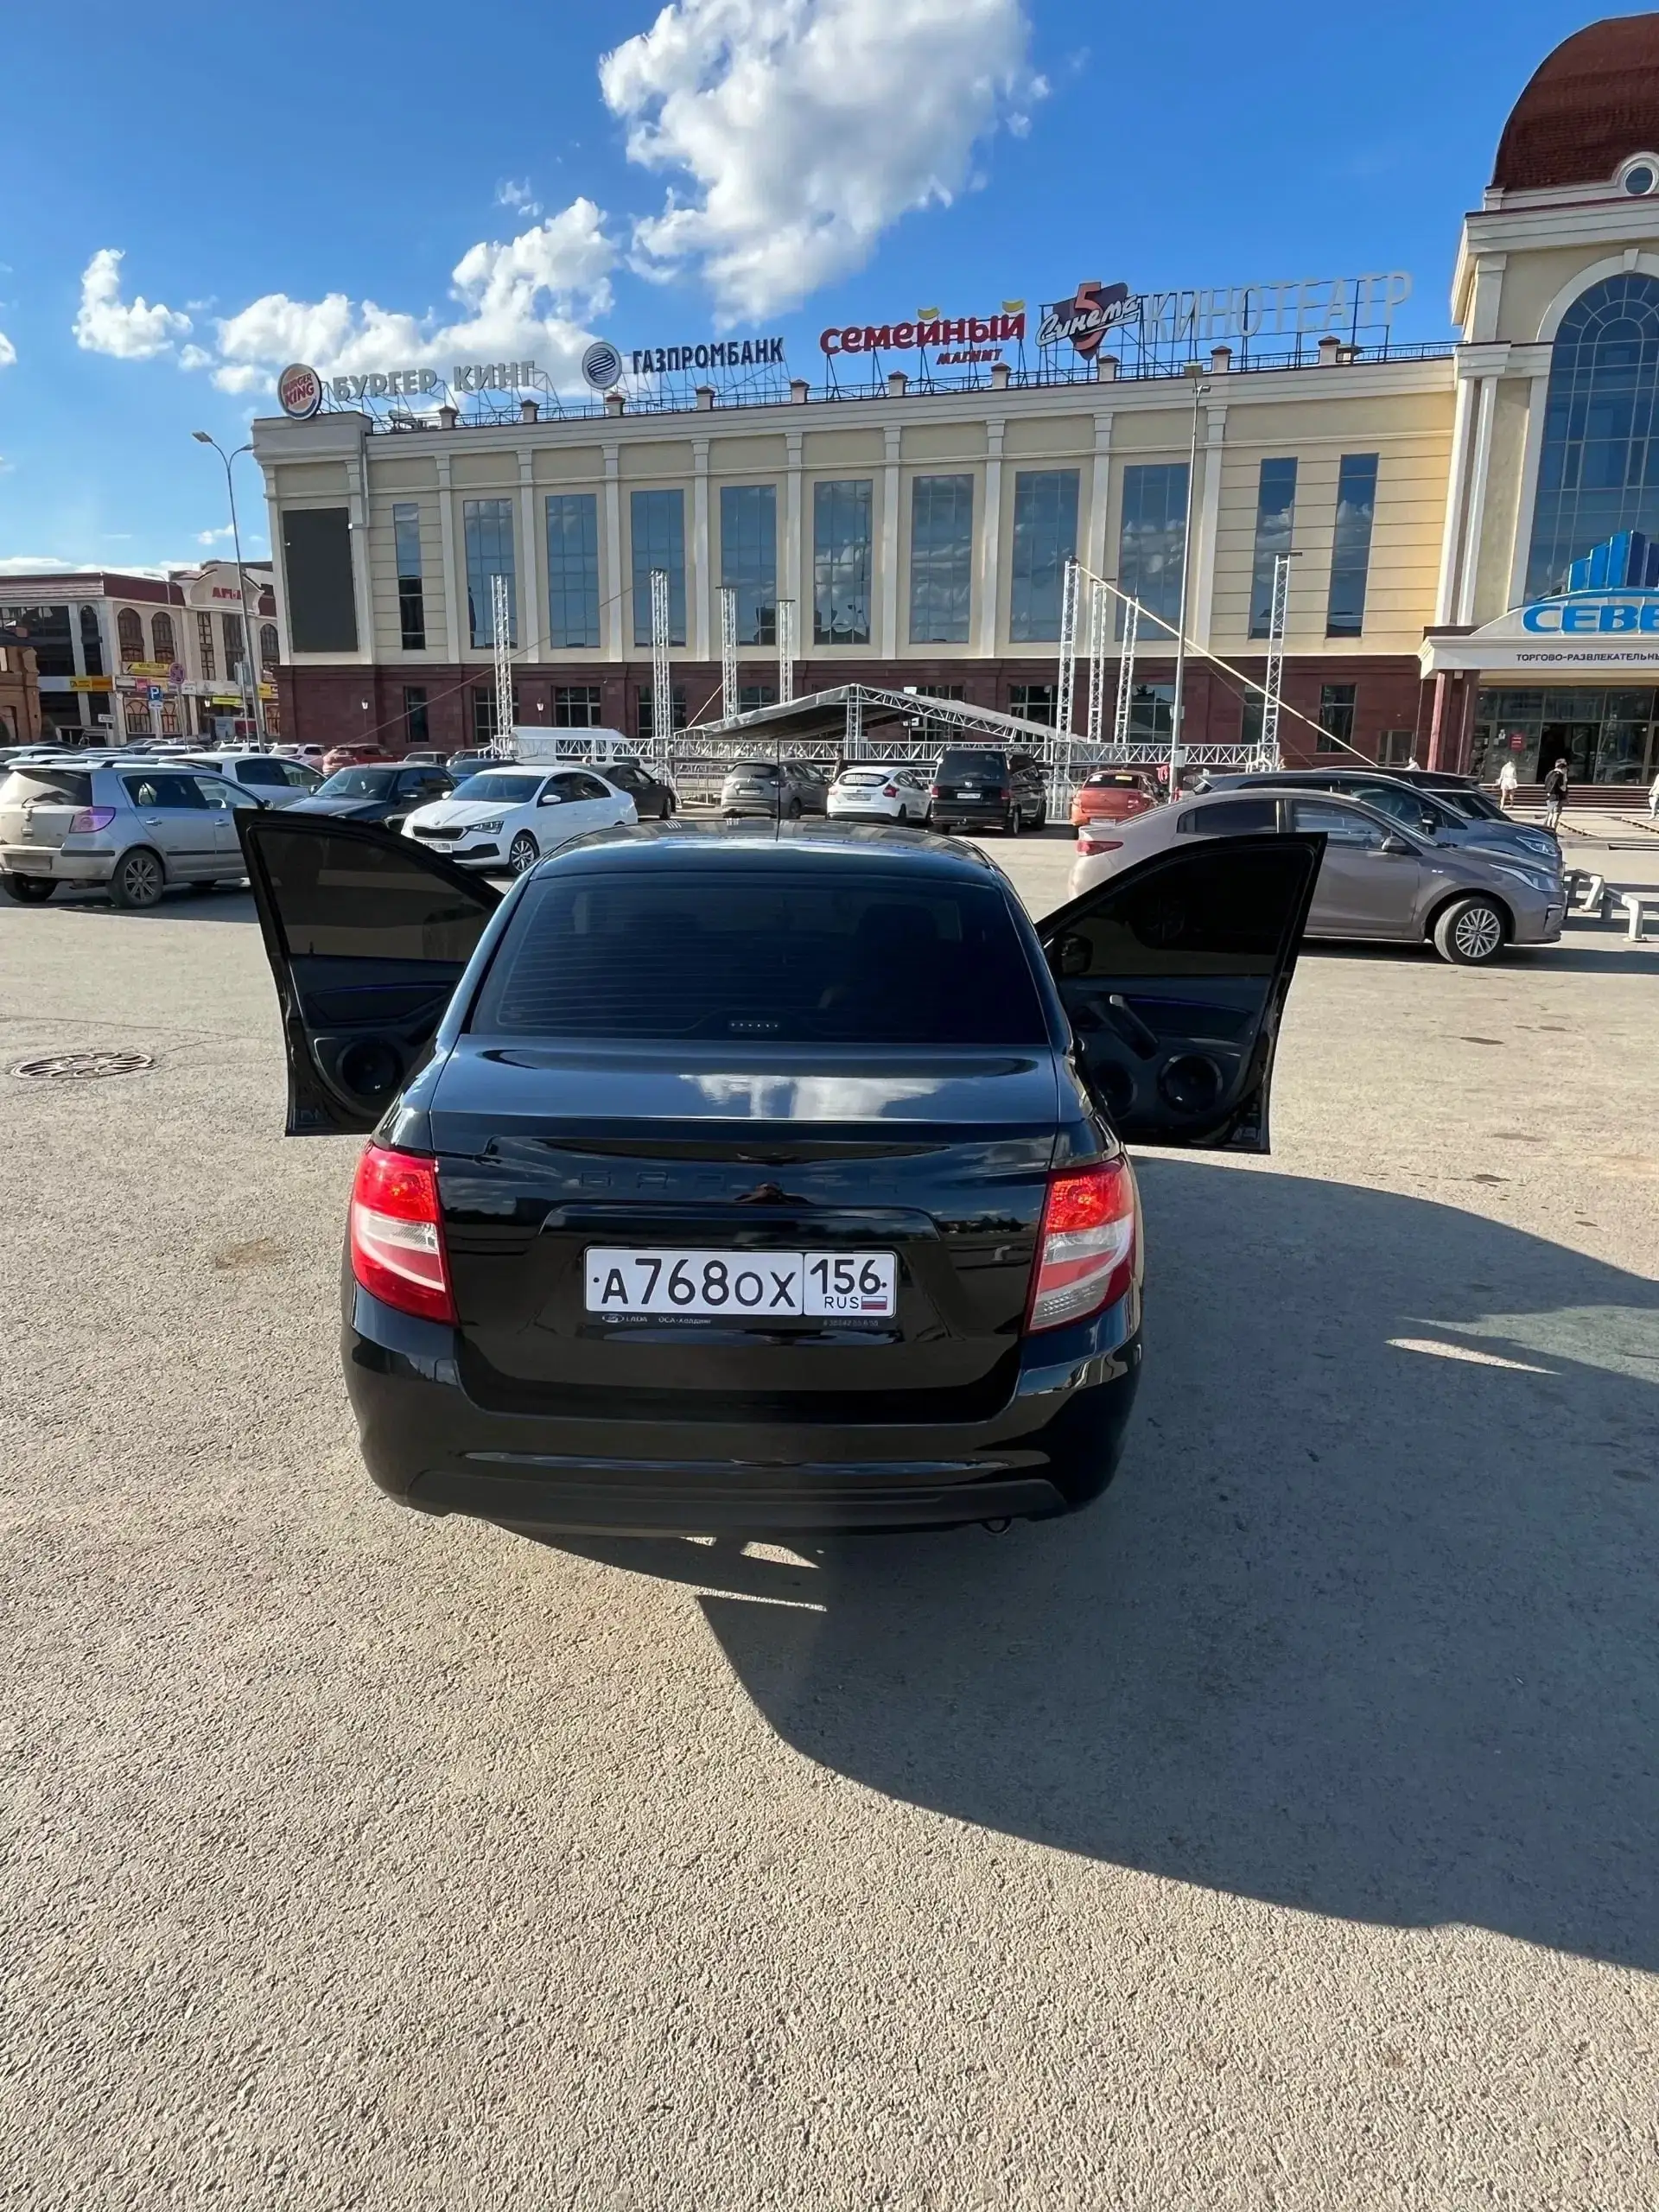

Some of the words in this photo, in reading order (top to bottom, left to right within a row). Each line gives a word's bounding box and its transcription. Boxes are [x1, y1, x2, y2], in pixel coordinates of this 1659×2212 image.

[1142, 271, 1412, 344] КИНОТЕАТР
[632, 337, 784, 374] ГАЗПРОМБАНК
[286, 382, 315, 404] KING
[332, 368, 437, 402] БУРГЕР
[453, 359, 535, 392] КИНГ
[150, 687, 160, 699] P
[809, 1259, 881, 1294] 156
[824, 1297, 859, 1310] RUS
